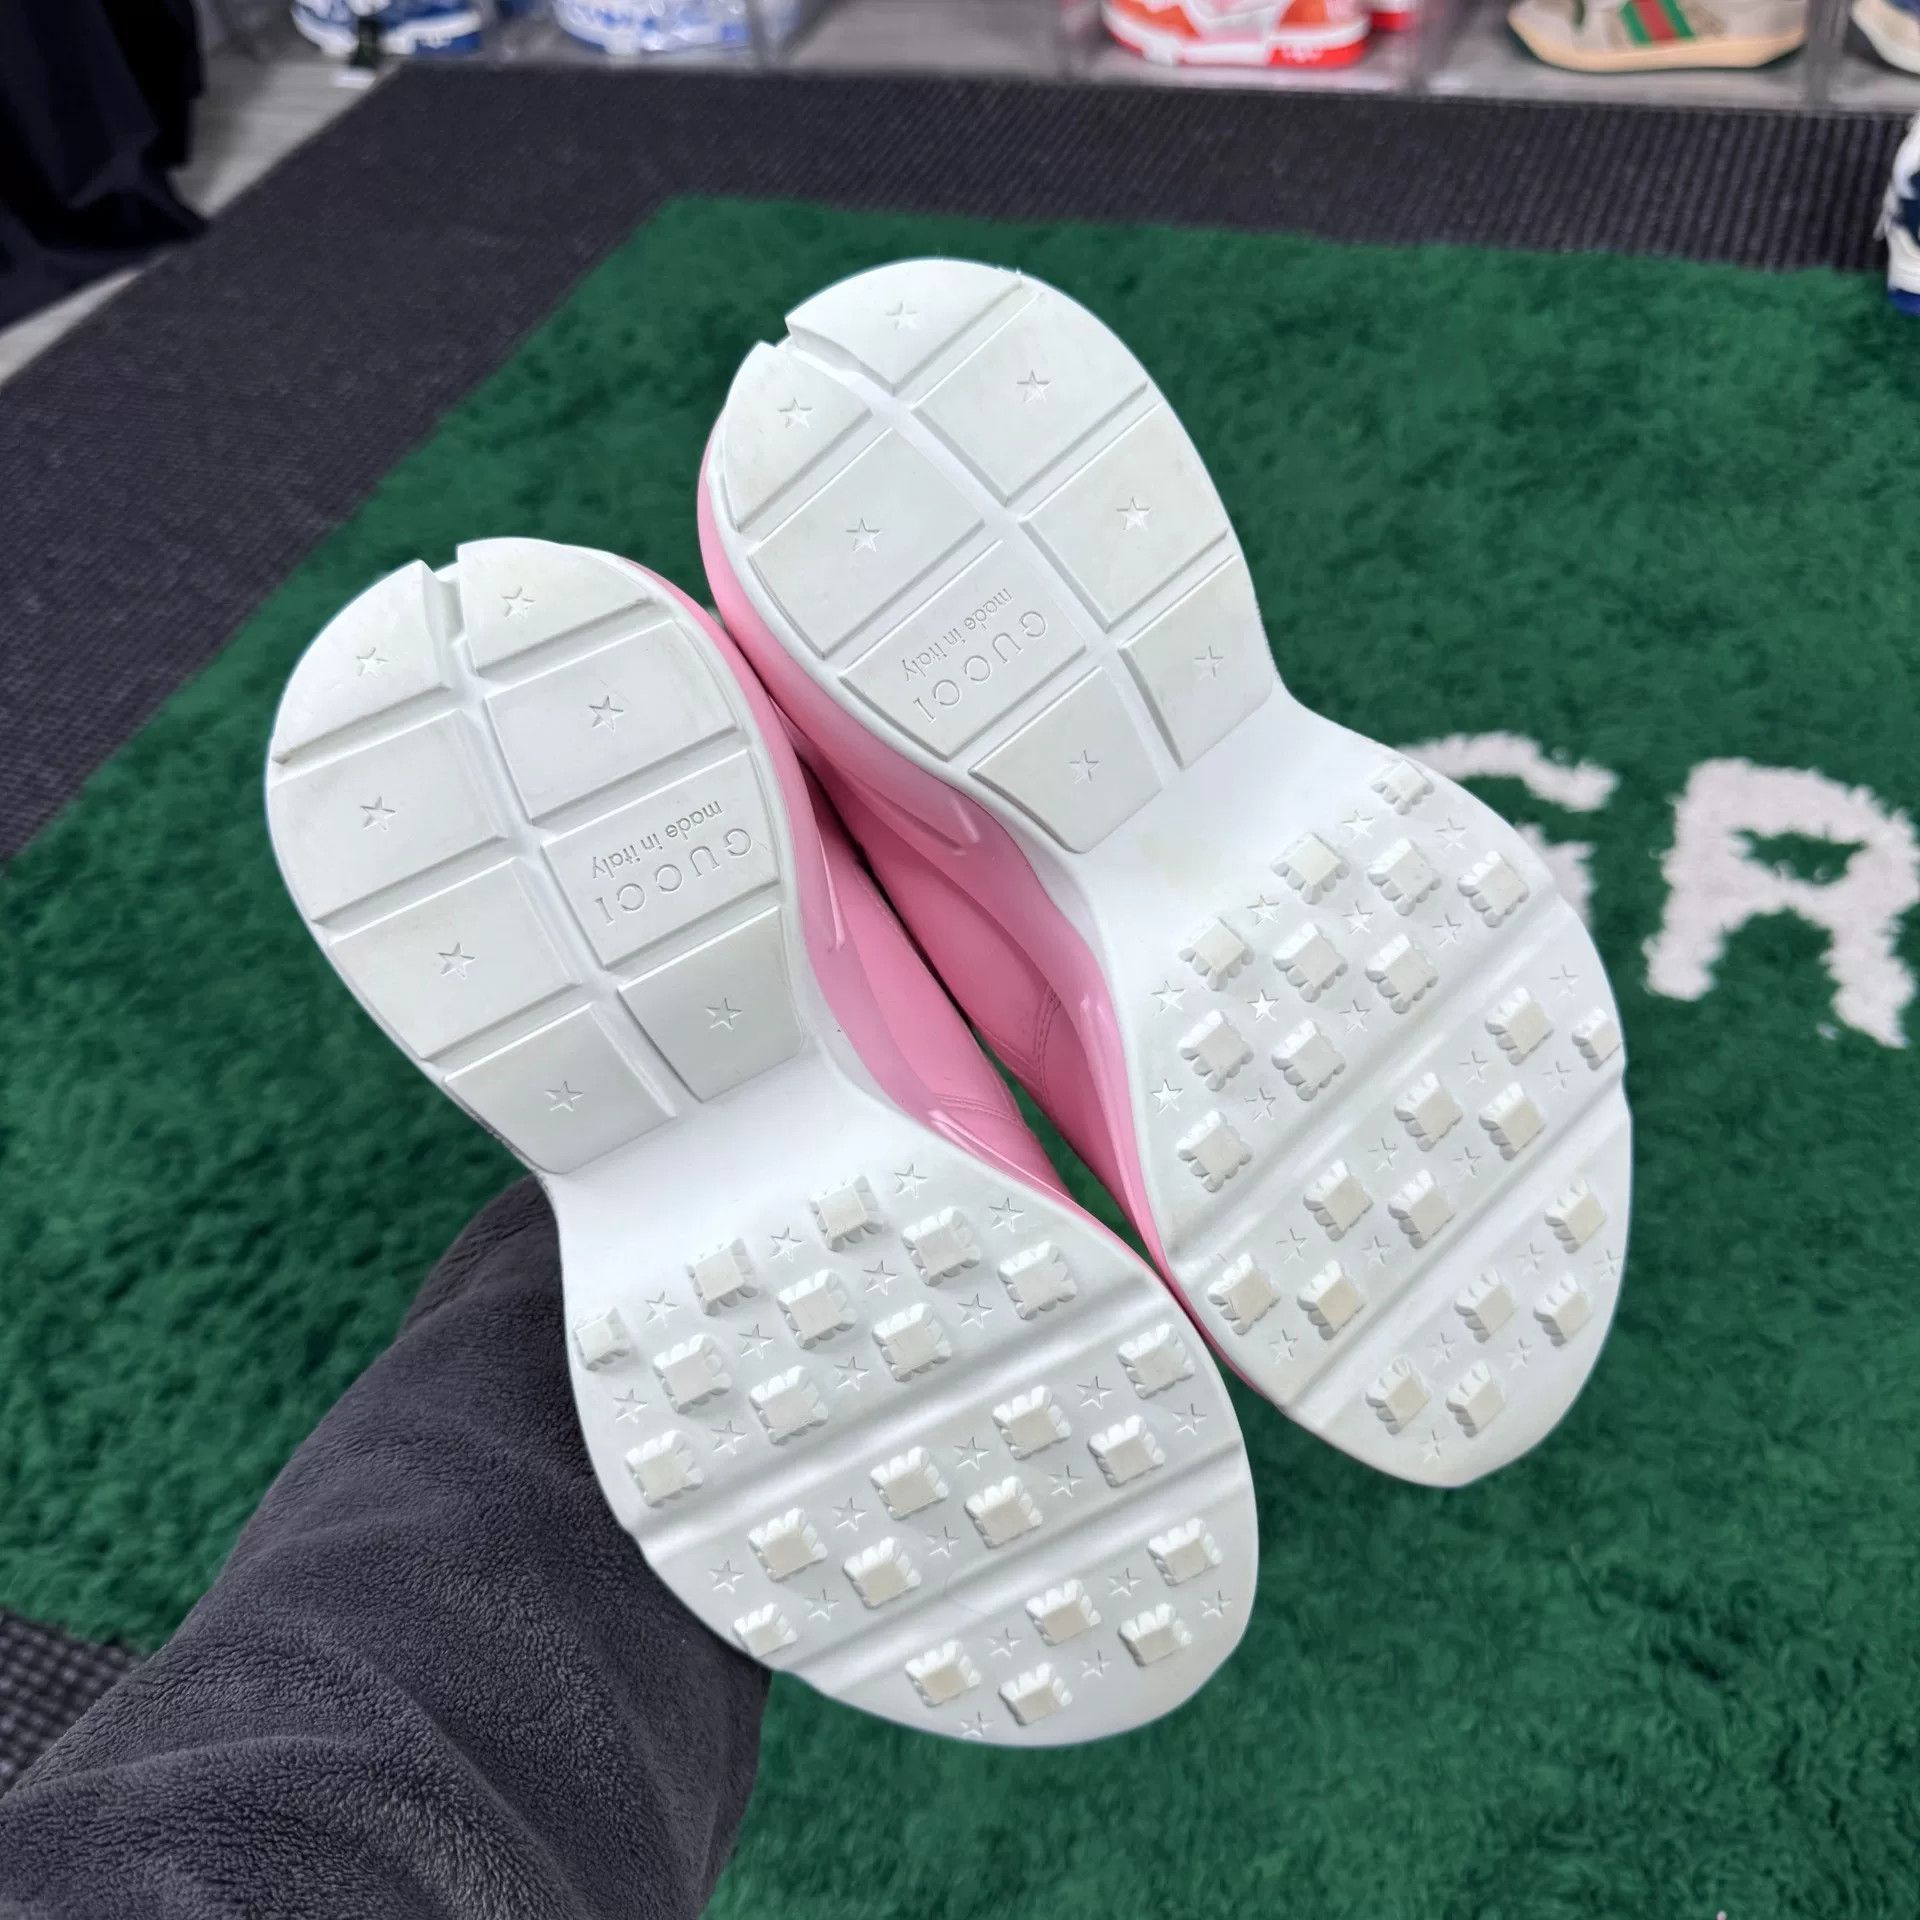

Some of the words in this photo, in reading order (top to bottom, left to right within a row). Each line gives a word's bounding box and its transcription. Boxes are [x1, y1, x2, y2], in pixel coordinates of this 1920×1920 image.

[964, 588, 1013, 630] made
[943, 628, 966, 646] in
[913, 611, 1047, 723] GUCCI
[665, 801, 723, 840] made
[640, 833, 663, 850] in
[592, 844, 641, 879] italy
[594, 828, 752, 926] GUCCI
